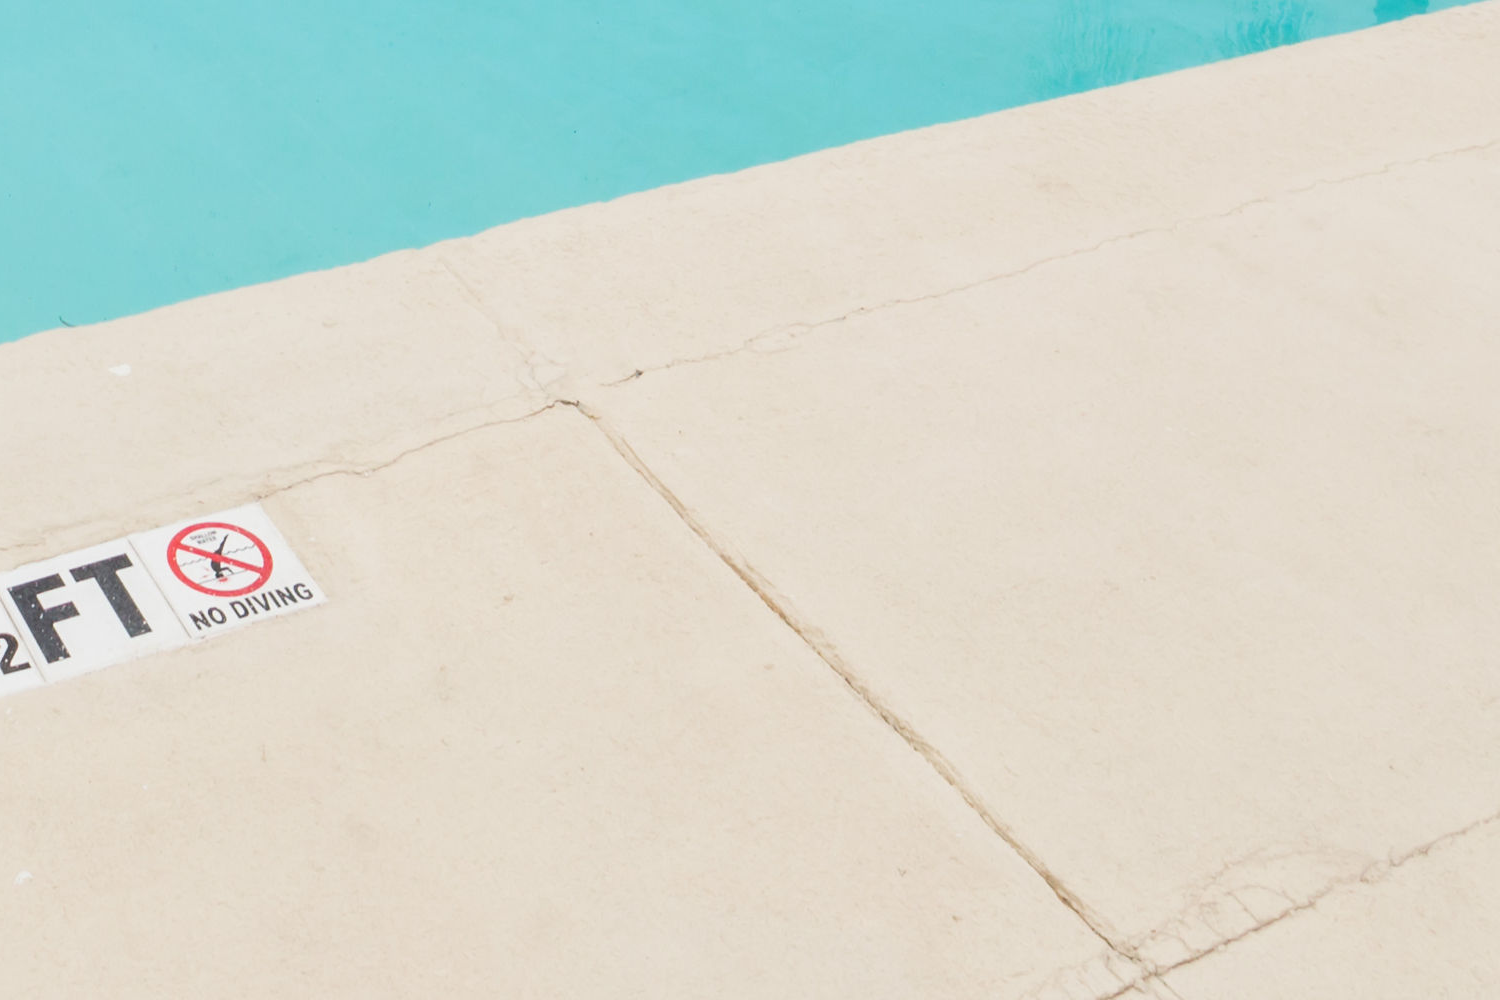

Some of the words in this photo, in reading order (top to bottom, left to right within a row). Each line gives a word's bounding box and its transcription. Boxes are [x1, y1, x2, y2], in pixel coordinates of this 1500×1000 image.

[9, 553, 152, 664] FT
[189, 607, 226, 630] NO
[230, 583, 313, 619] DIVING
